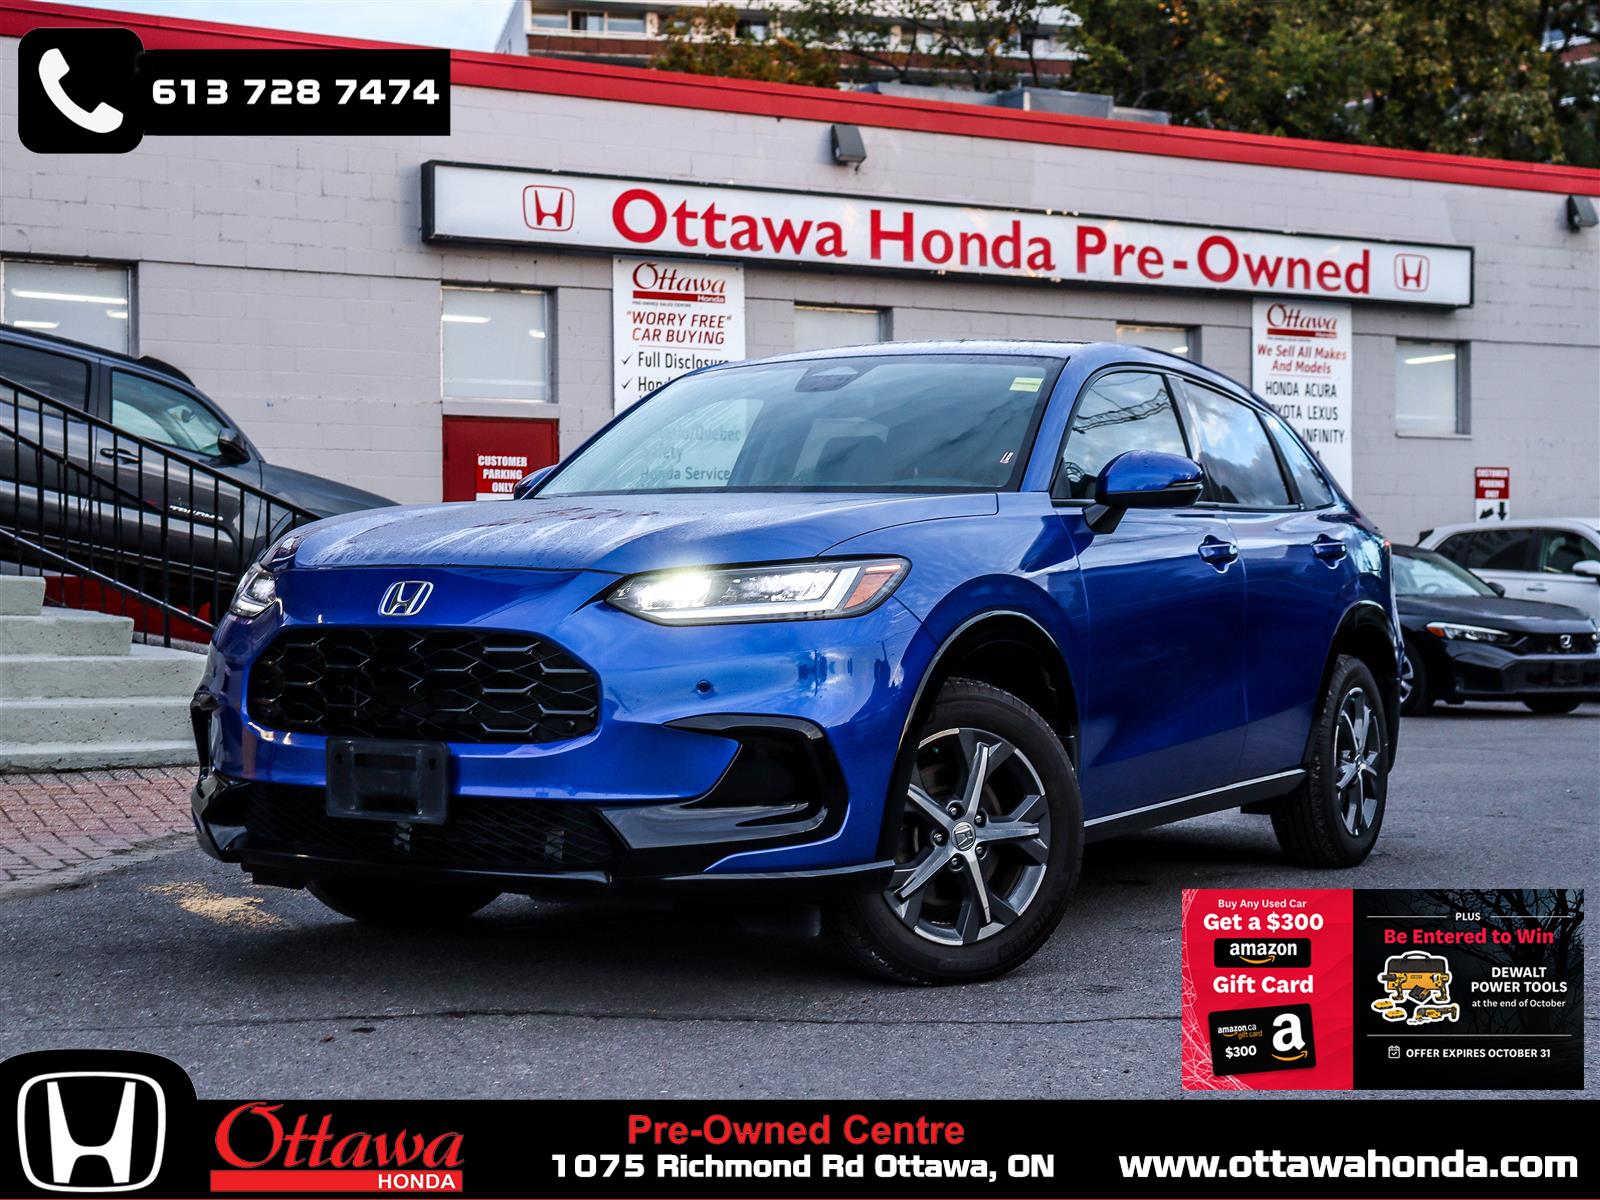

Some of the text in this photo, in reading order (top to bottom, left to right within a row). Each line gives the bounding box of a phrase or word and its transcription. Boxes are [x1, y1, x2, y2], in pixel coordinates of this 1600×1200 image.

[613, 189, 1369, 292] Ottawa Honda Pre-Owned
[632, 261, 726, 293] Ottawa
[697, 295, 725, 303] Honda
[1267, 303, 1337, 330] Ottawa
[632, 327, 724, 345] CAR BUYING
[1257, 343, 1347, 360] We Sell All Makes
[638, 351, 730, 371] Full Disclosu
[1271, 360, 1331, 374] And Models
[1266, 381, 1337, 398] HONDA ACURA
[1308, 406, 1338, 420] LEXUS
[1302, 428, 1345, 444] INFINITY
[477, 455, 528, 467] CUSTOMER
[482, 468, 523, 480] PARKING
[685, 466, 731, 481] Service
[491, 481, 514, 492] ONLY
